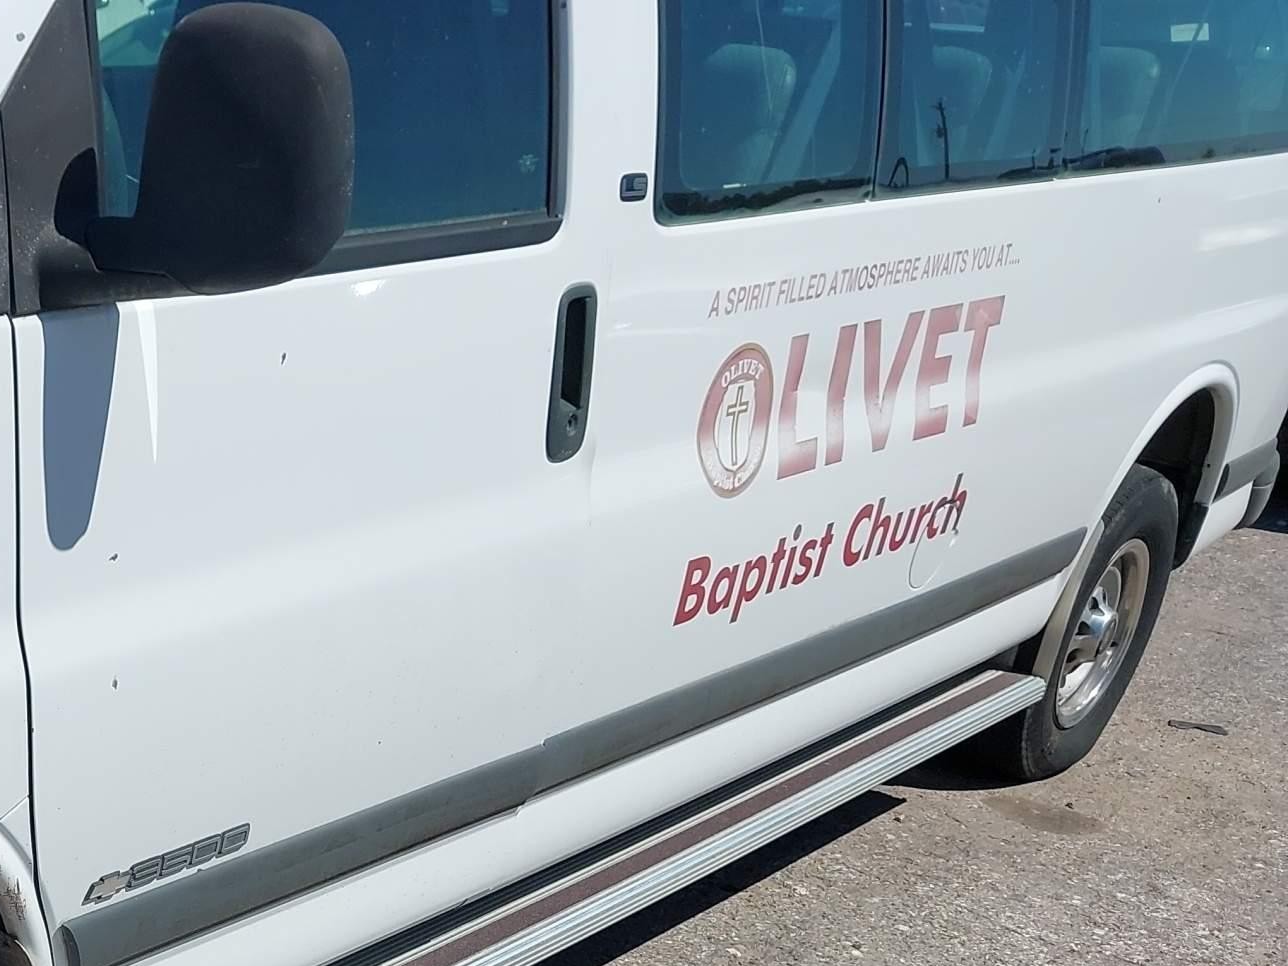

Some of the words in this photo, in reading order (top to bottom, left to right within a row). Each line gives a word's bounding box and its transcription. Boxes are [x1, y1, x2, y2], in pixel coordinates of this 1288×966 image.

[707, 289, 720, 318] A
[724, 280, 776, 315] SPIRIT
[776, 272, 827, 306] FILLED
[827, 256, 921, 297] ATMOSPHERE
[920, 248, 969, 280] AWAITS
[970, 245, 997, 271] YOU
[721, 358, 764, 388] OLIVET
[673, 522, 834, 626] Baptist
[842, 473, 968, 567] Church
